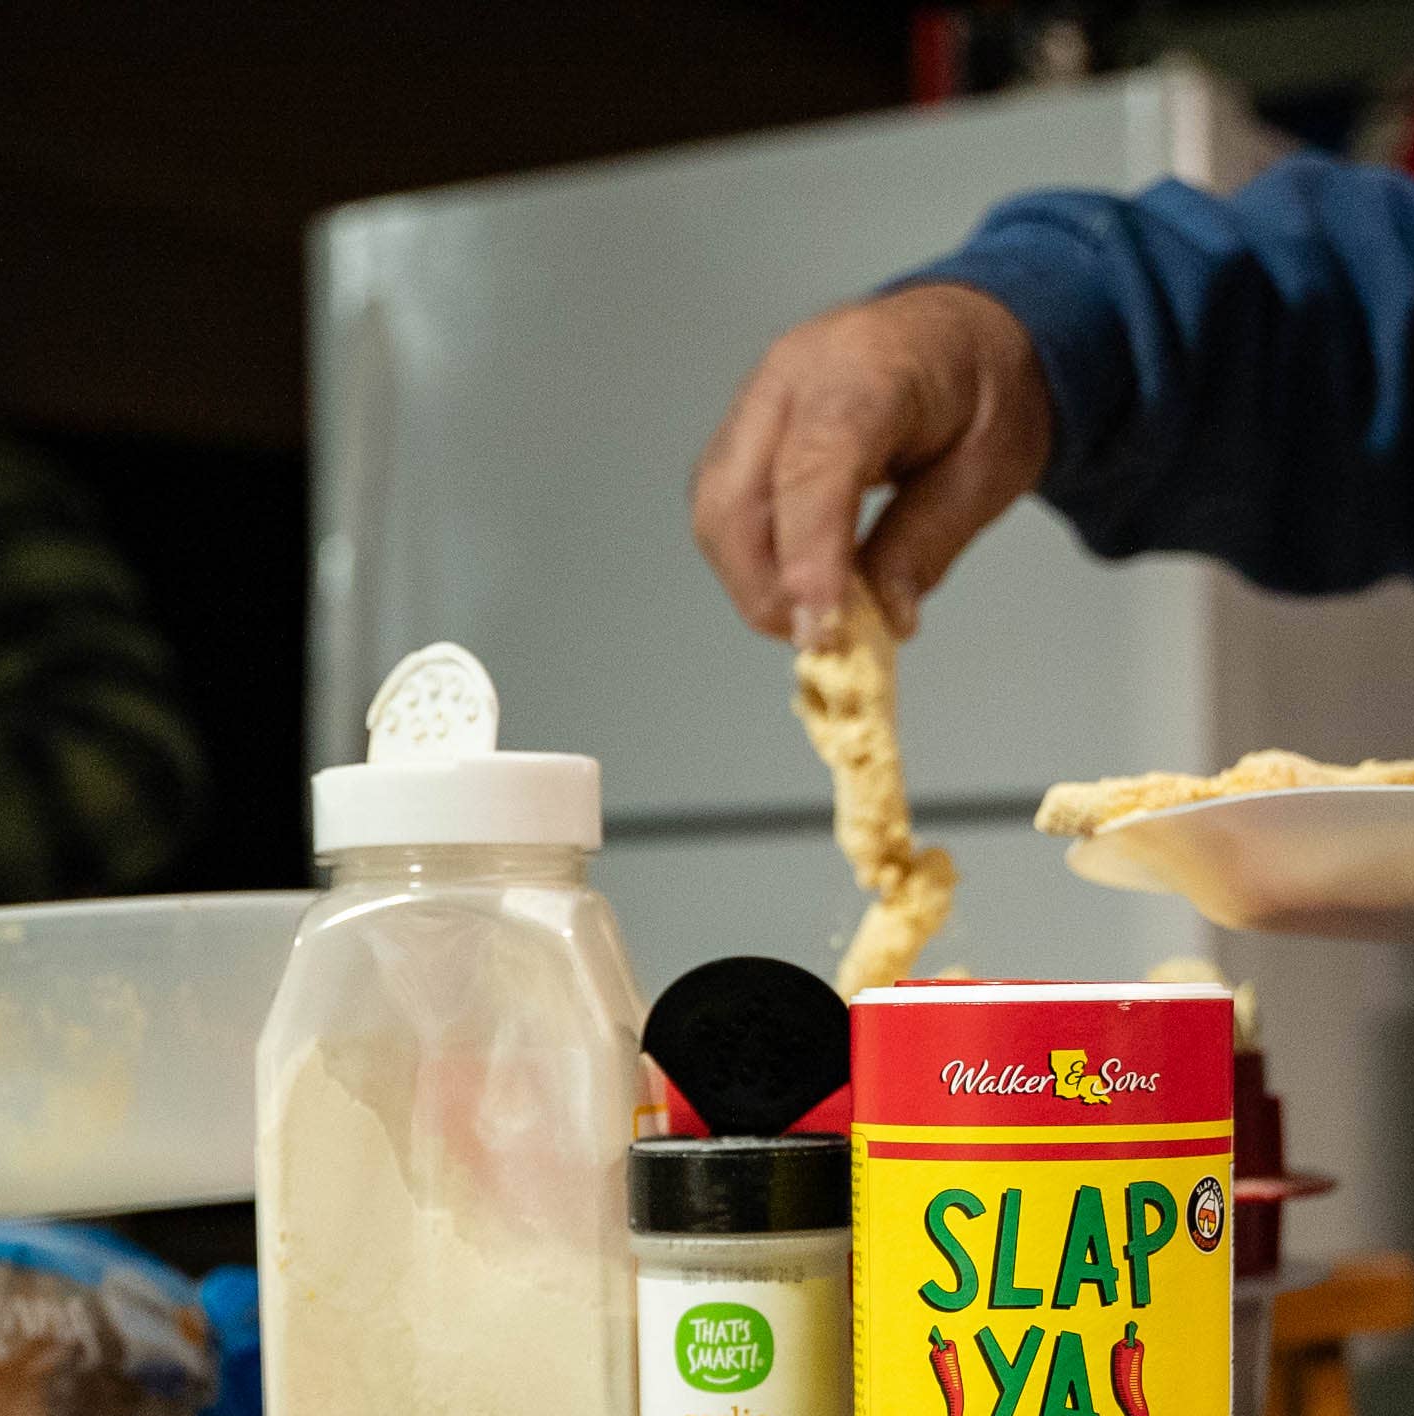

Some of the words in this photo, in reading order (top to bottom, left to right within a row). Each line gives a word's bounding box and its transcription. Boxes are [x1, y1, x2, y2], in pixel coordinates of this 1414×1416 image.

[941, 1059, 1056, 1097] Walker
[1064, 1060, 1088, 1092] &
[1091, 1057, 1162, 1097] Sons
[1196, 1180, 1212, 1196] SLAP
[918, 1180, 1178, 1313] SLAP
[689, 1316, 752, 1346] THAT'S
[686, 1344, 759, 1375] SMART!
